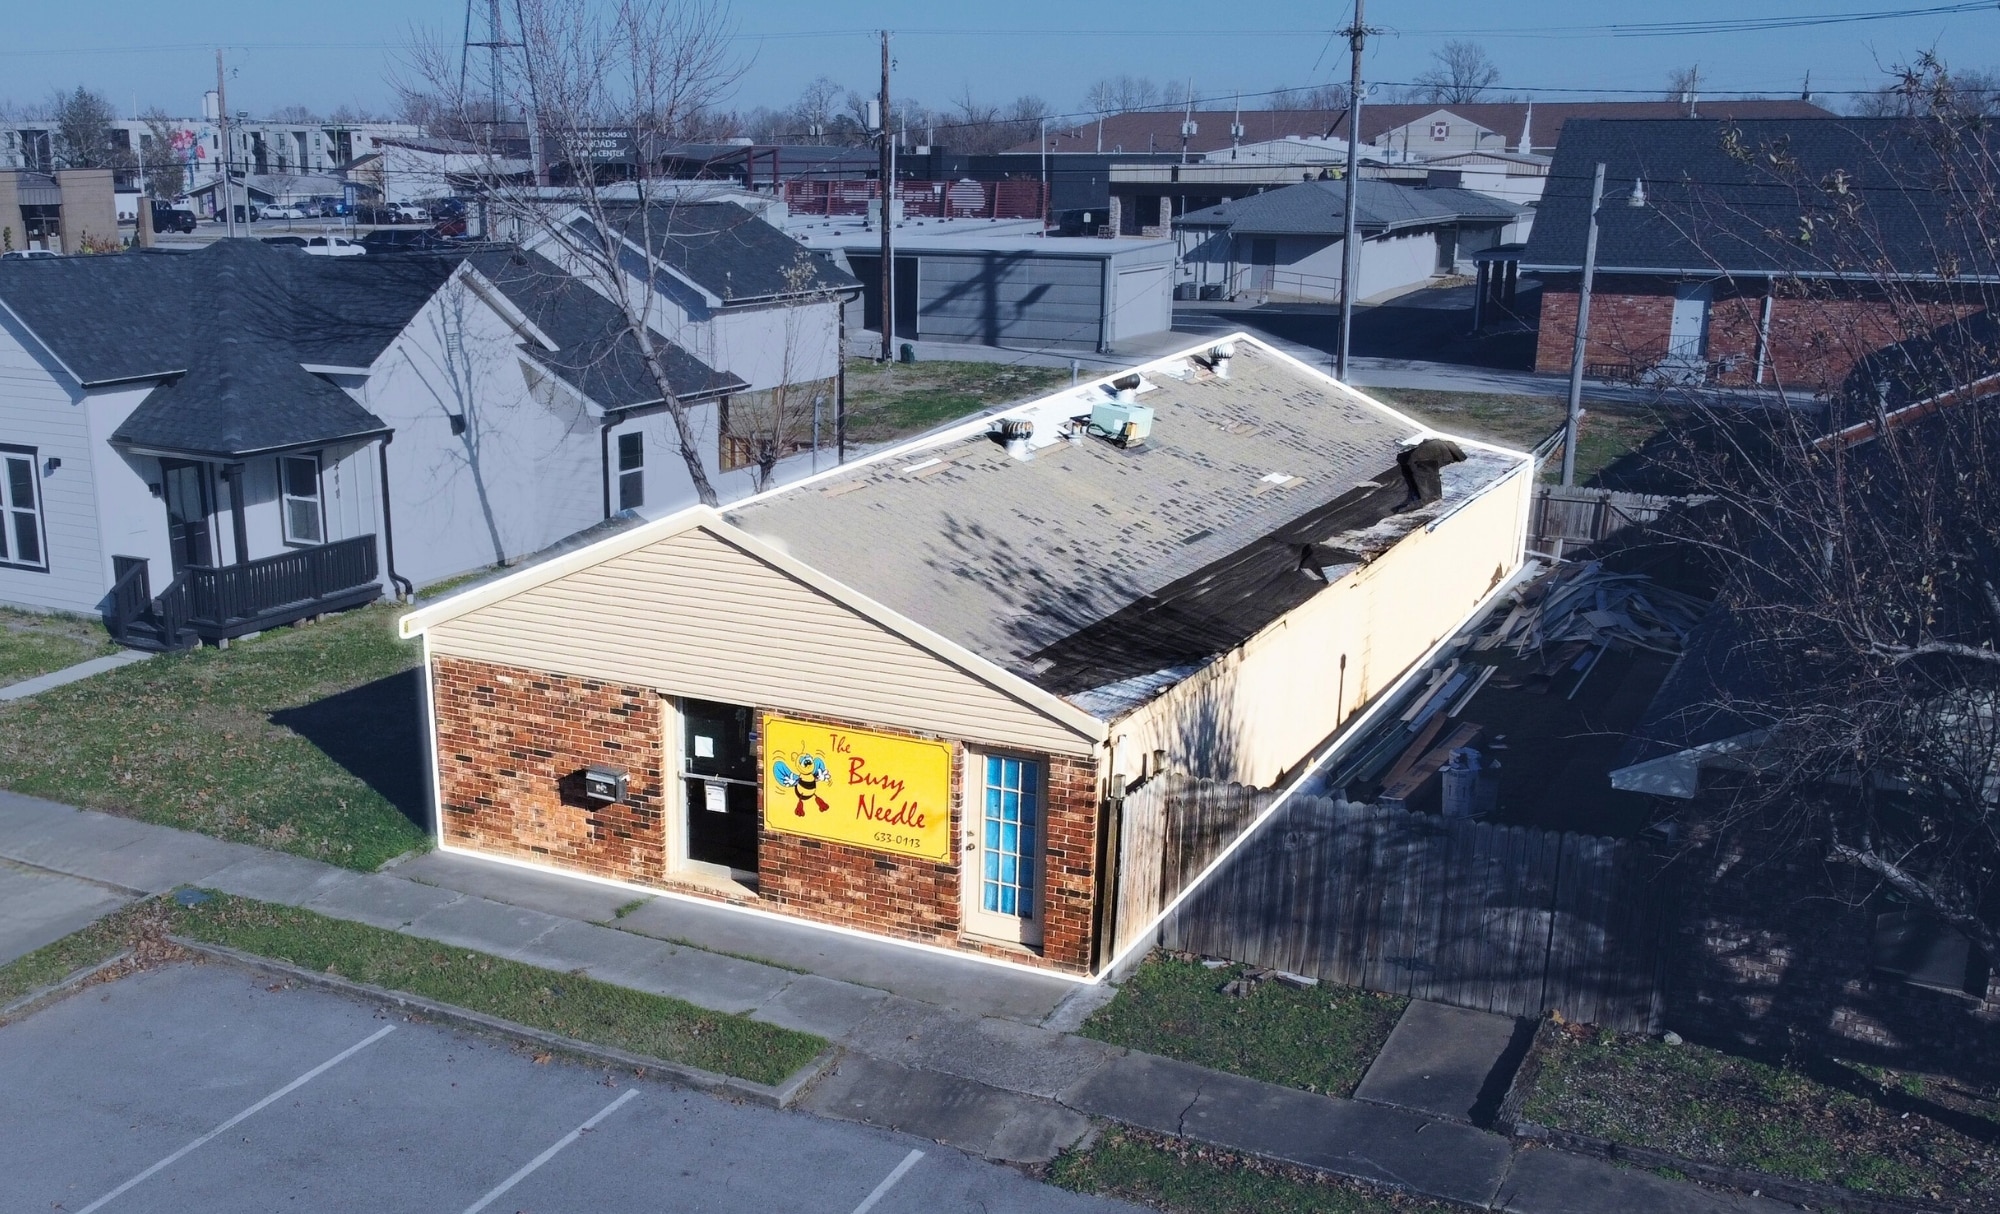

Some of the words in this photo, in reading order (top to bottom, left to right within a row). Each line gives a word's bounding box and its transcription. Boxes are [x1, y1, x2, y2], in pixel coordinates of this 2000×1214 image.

[830, 734, 851, 753] The
[848, 756, 905, 801] Busy
[856, 793, 926, 829] Needle
[874, 832, 920, 848] 633-0113
